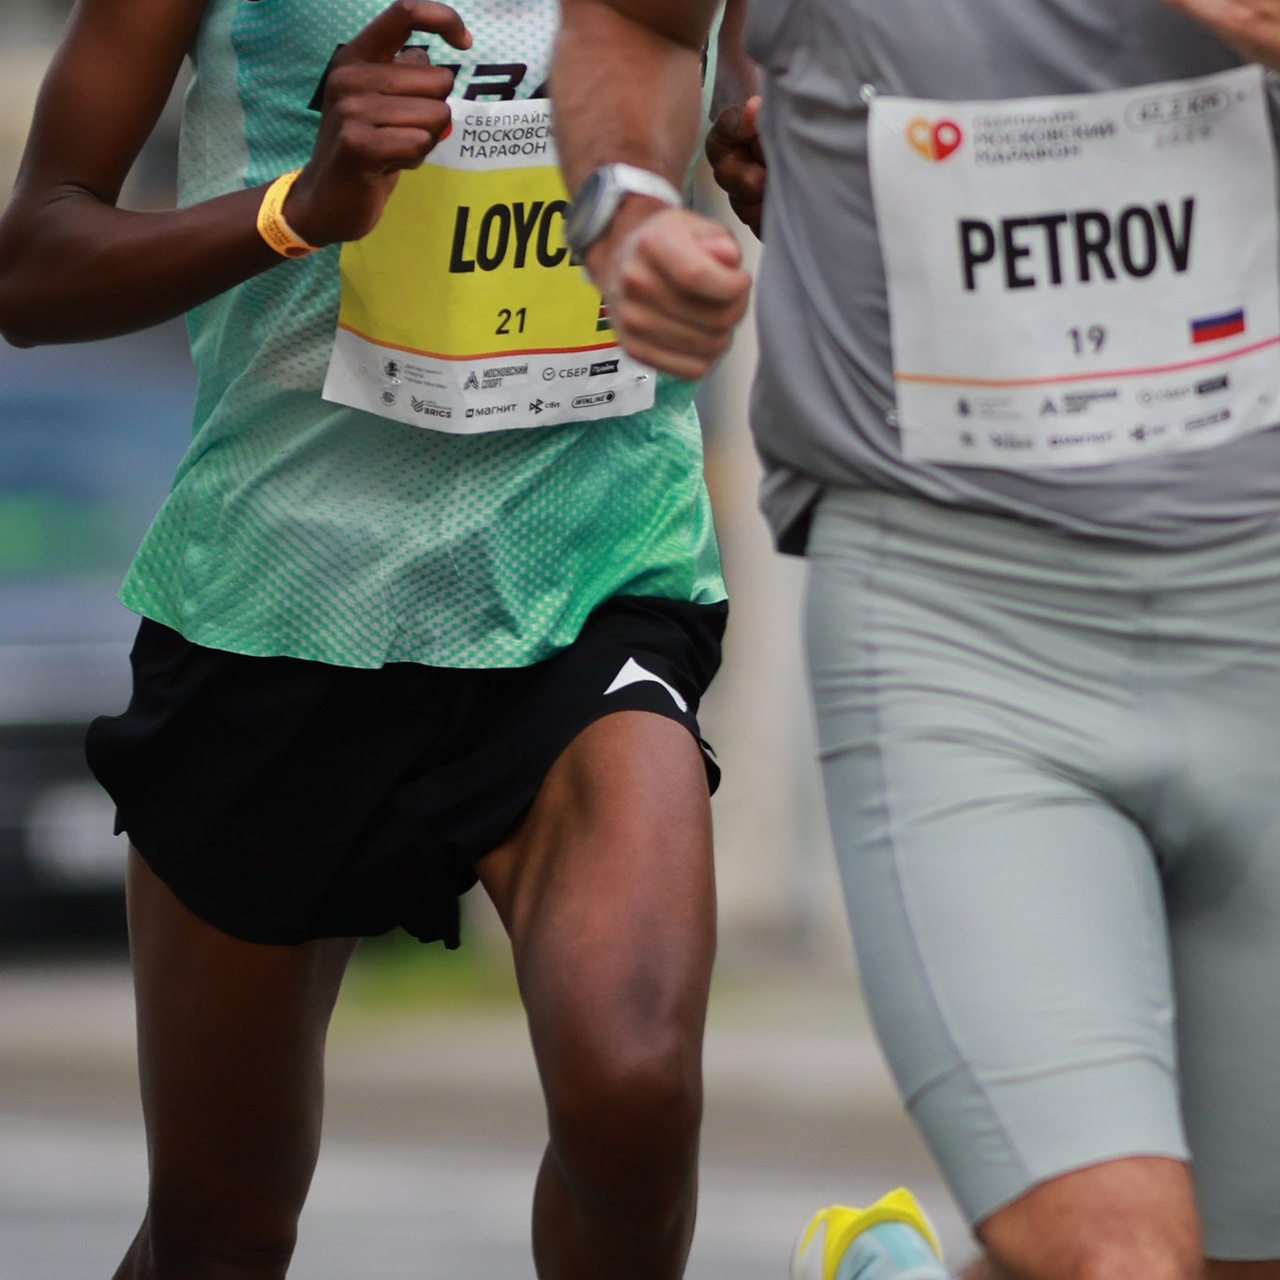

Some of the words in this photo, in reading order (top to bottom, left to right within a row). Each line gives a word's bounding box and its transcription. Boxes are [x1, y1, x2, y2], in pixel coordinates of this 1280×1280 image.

[460, 141, 547, 158] МАРАФОН
[449, 200, 582, 273] LOYC
[960, 197, 1195, 291] PETROV
[495, 307, 526, 335] 21
[1069, 325, 1106, 355] 19
[483, 363, 528, 378] МОСКОВСКИЙ
[558, 367, 588, 378] СБЕР
[481, 378, 502, 389] СПОРТ
[575, 394, 606, 405] WINLINE
[424, 407, 452, 419] BRICS
